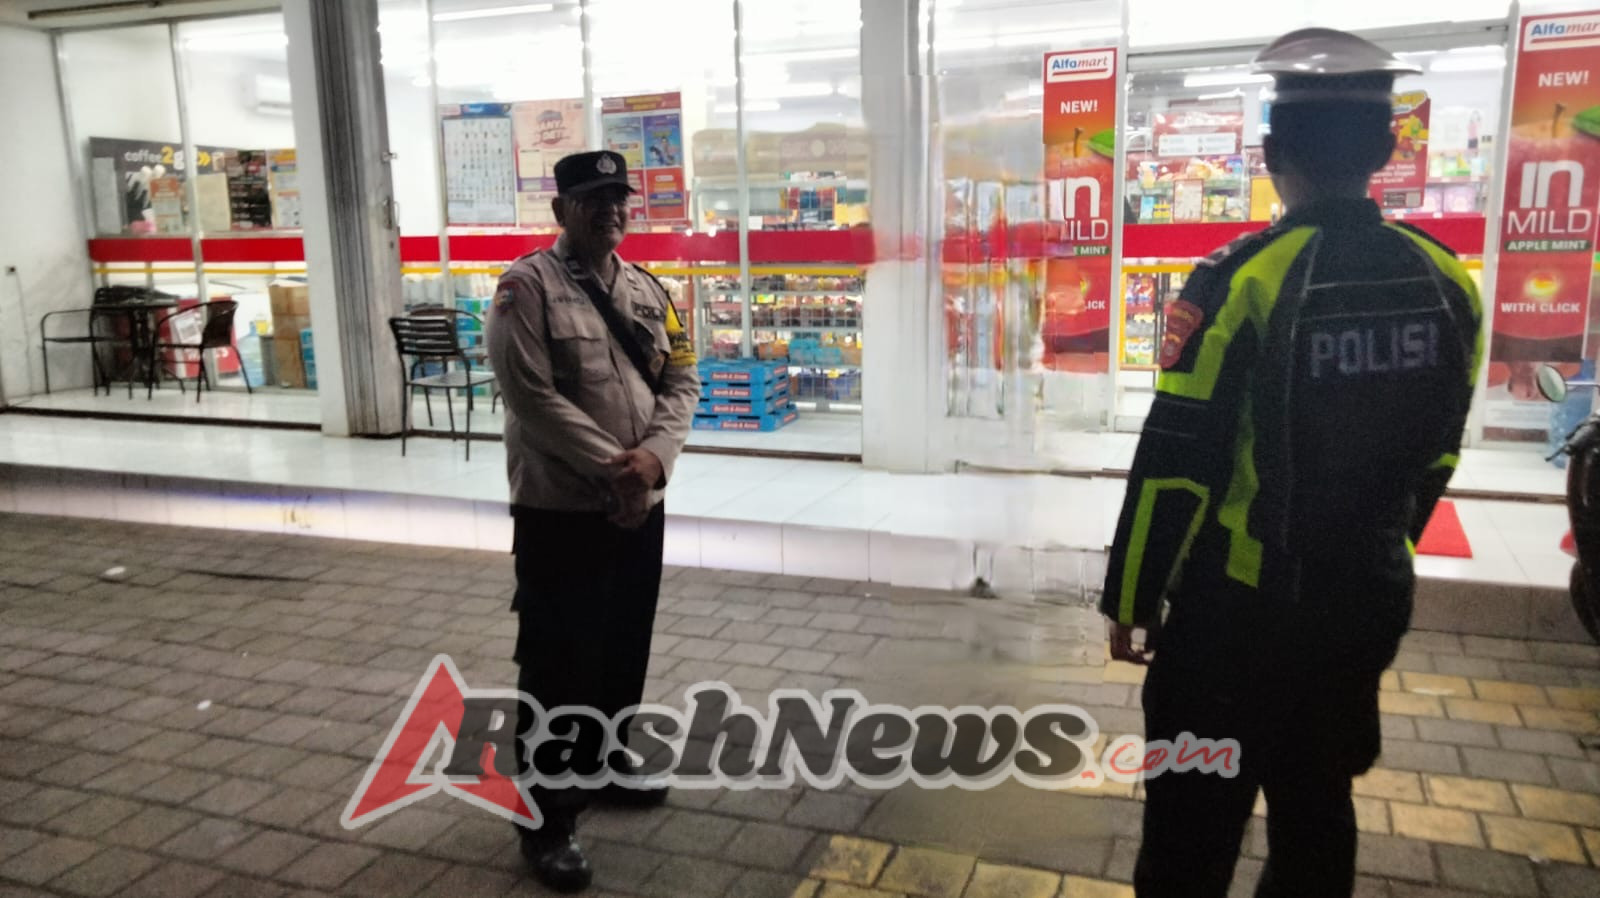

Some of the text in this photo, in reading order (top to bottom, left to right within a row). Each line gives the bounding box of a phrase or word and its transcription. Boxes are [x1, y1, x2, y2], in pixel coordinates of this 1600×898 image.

[1530, 20, 1600, 36] Alfamar
[1052, 55, 1108, 70] Alfamart
[1537, 69, 1590, 89] NEW!
[1060, 98, 1098, 115] NEW!
[1507, 208, 1592, 236] MILD
[1080, 245, 1108, 256] MINT
[1506, 239, 1588, 251] APPLE MINT
[1500, 301, 1581, 314] WITH CLICK
[1310, 319, 1438, 379] POLISI
